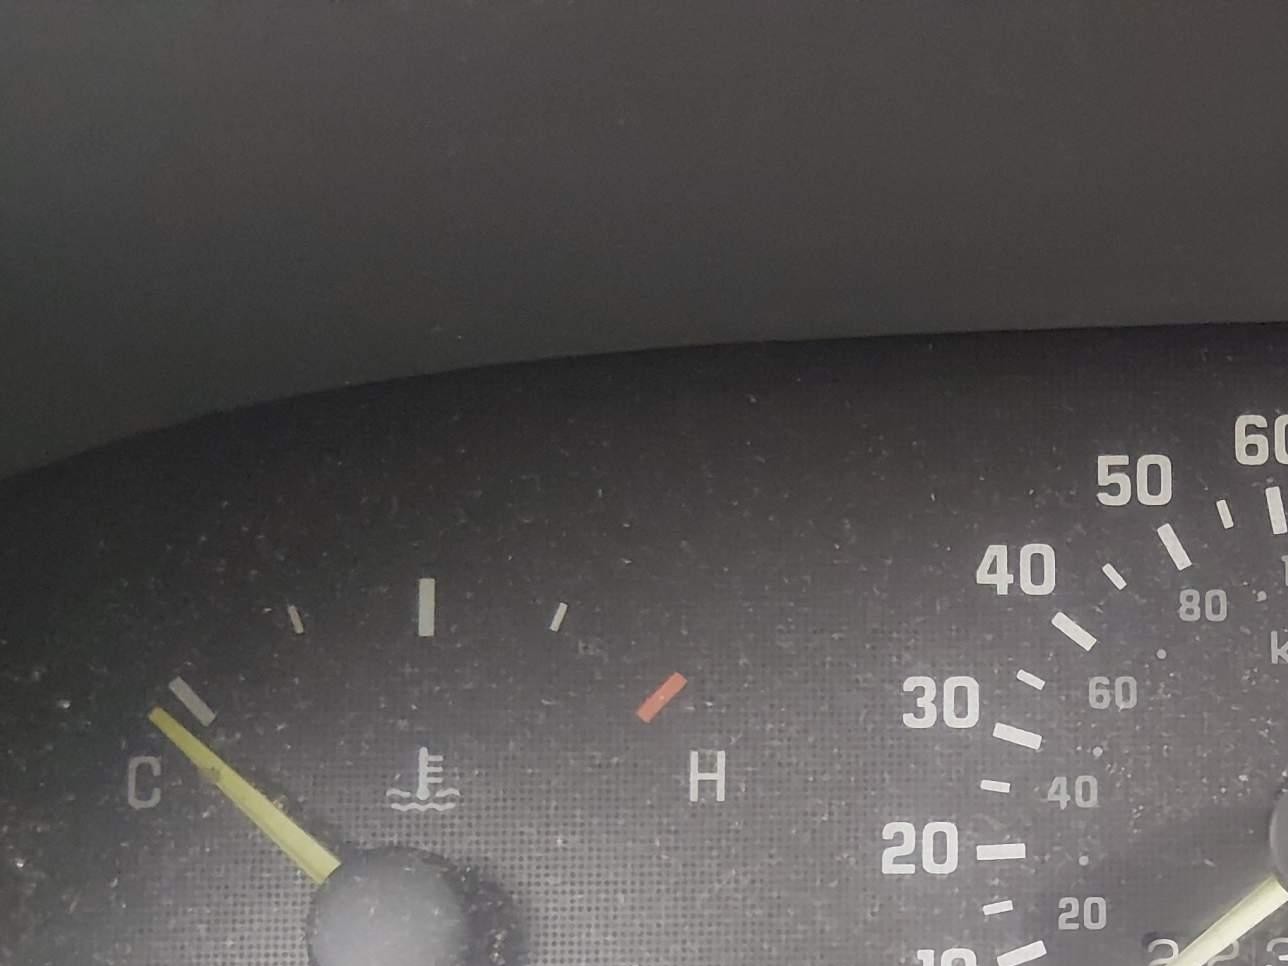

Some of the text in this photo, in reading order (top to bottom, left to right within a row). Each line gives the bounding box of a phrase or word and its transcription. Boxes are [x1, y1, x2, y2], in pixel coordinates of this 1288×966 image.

[1097, 454, 1173, 506] 50
[976, 543, 1056, 595] 40
[1179, 589, 1227, 621] 80
[902, 676, 979, 728] 30
[1088, 676, 1137, 709] 60
[127, 756, 162, 810] C
[690, 751, 725, 802] H
[1047, 775, 1098, 809] 40
[881, 822, 958, 874] 20
[1057, 897, 1107, 930] 20
